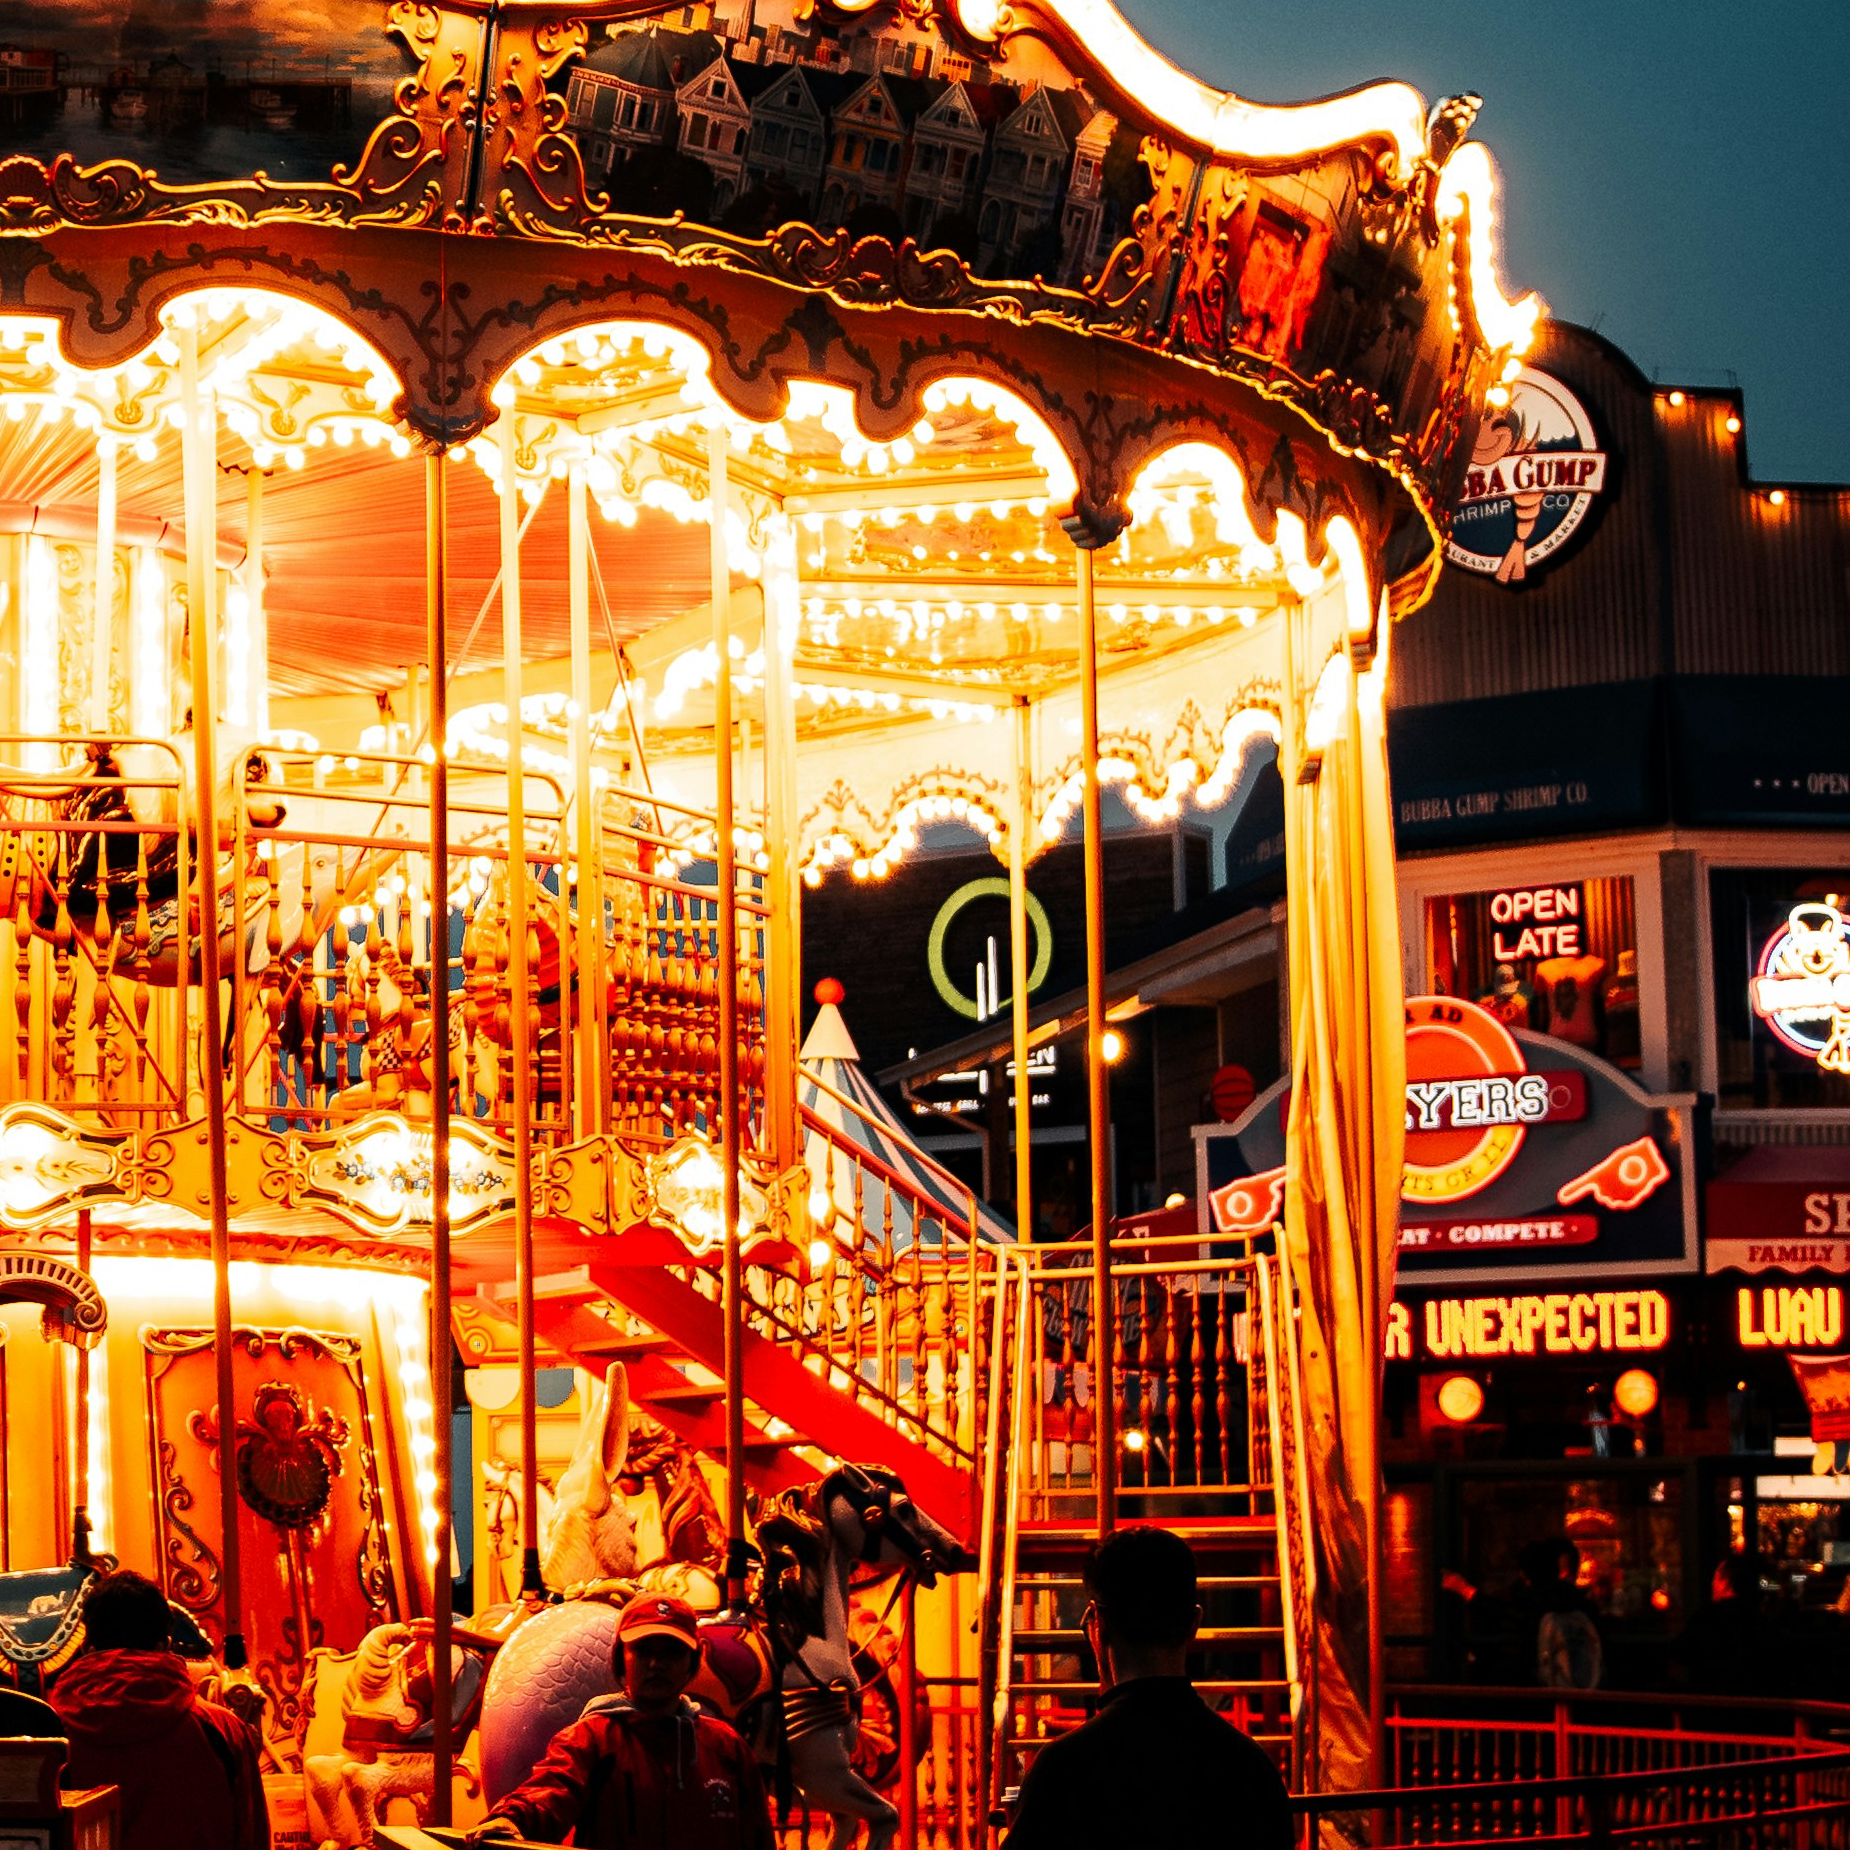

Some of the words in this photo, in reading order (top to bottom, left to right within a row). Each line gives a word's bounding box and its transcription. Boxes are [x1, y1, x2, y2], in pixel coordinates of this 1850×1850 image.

[1513, 456, 1597, 490] GUMP
[1454, 499, 1512, 524] HRIMP
[1451, 549, 1497, 570] URANT
[1543, 499, 1586, 552] MARKET
[1400, 797, 1453, 825] BUBBA
[1455, 791, 1499, 818] GUMP
[1503, 783, 1562, 813] SHRIMP
[1491, 887, 1579, 925] OPEN
[1493, 923, 1580, 962] LATE
[1405, 1074, 1549, 1130] YERS
[1397, 1227, 1431, 1247] AT
[1449, 1220, 1565, 1245] COMPETE
[1749, 1245, 1834, 1263] FAMILY
[1426, 1289, 1667, 1355] UNEXPECTED
[1738, 1286, 1843, 1346] LUAU
